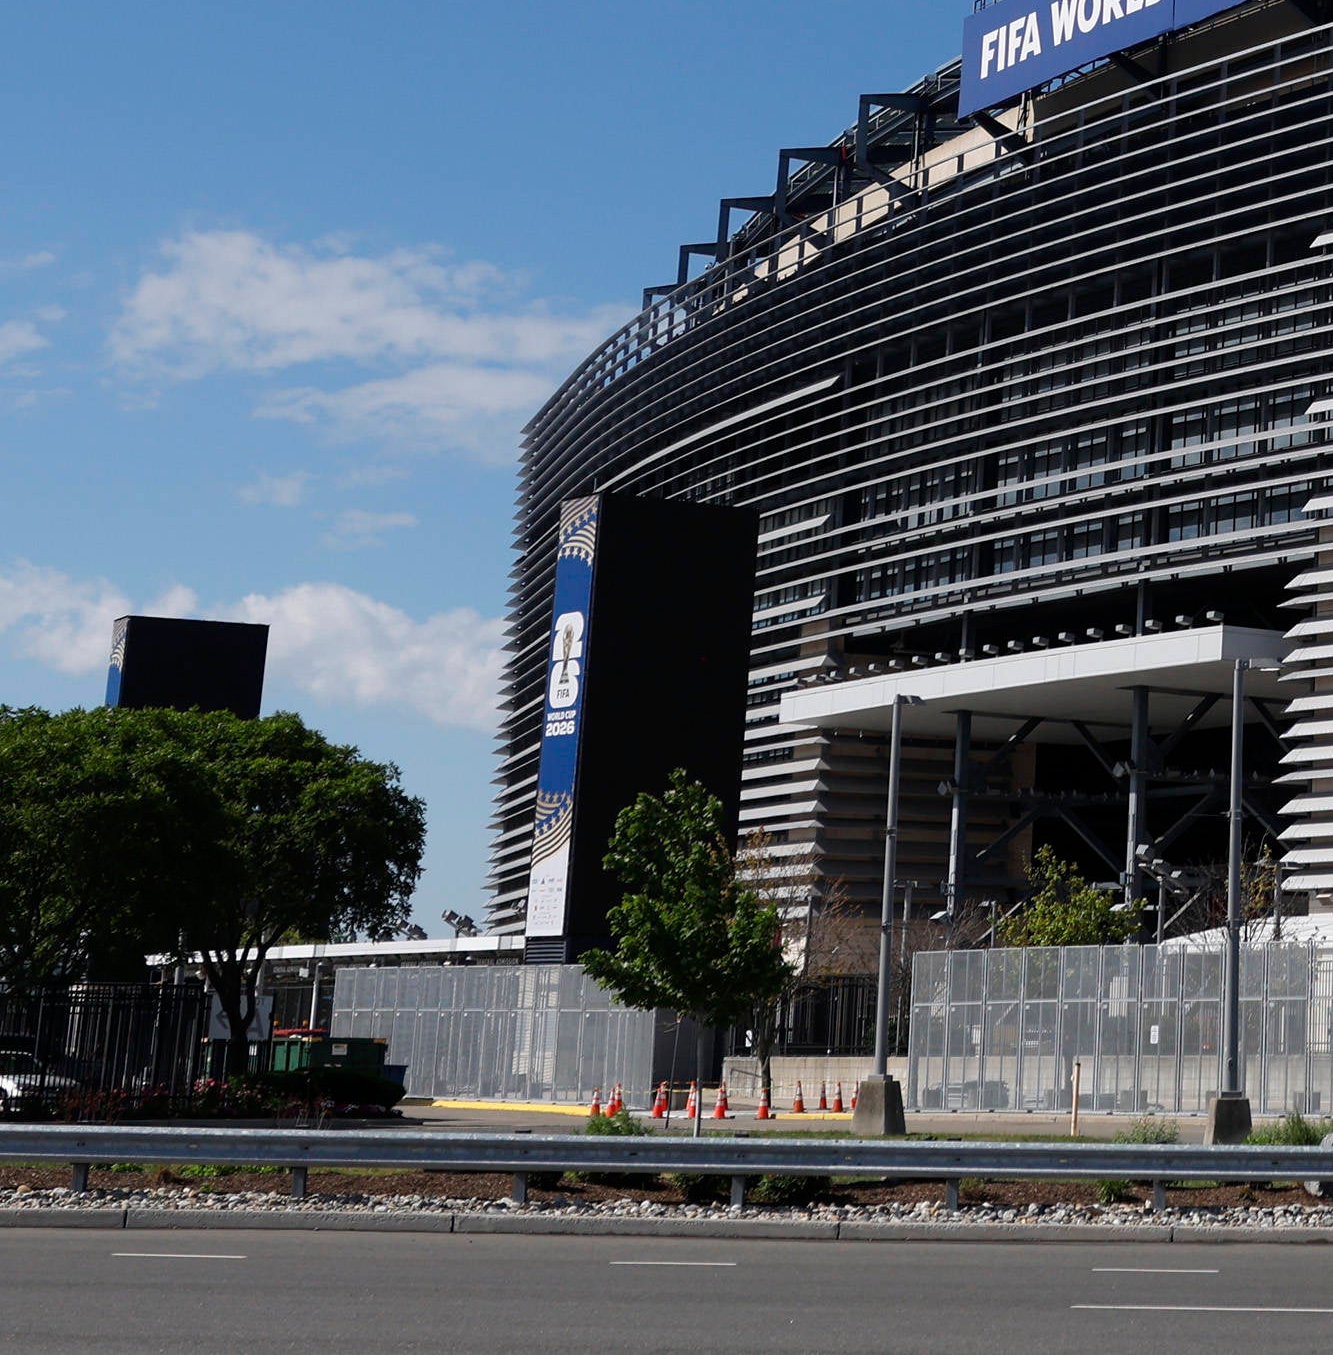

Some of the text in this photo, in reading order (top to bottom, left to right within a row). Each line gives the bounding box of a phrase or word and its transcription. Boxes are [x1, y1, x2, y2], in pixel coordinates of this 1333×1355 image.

[980, 11, 1042, 80] FIFA
[556, 688, 570, 700] FIFA
[547, 710, 577, 722] WORLD CUP
[545, 720, 576, 737] 2026
